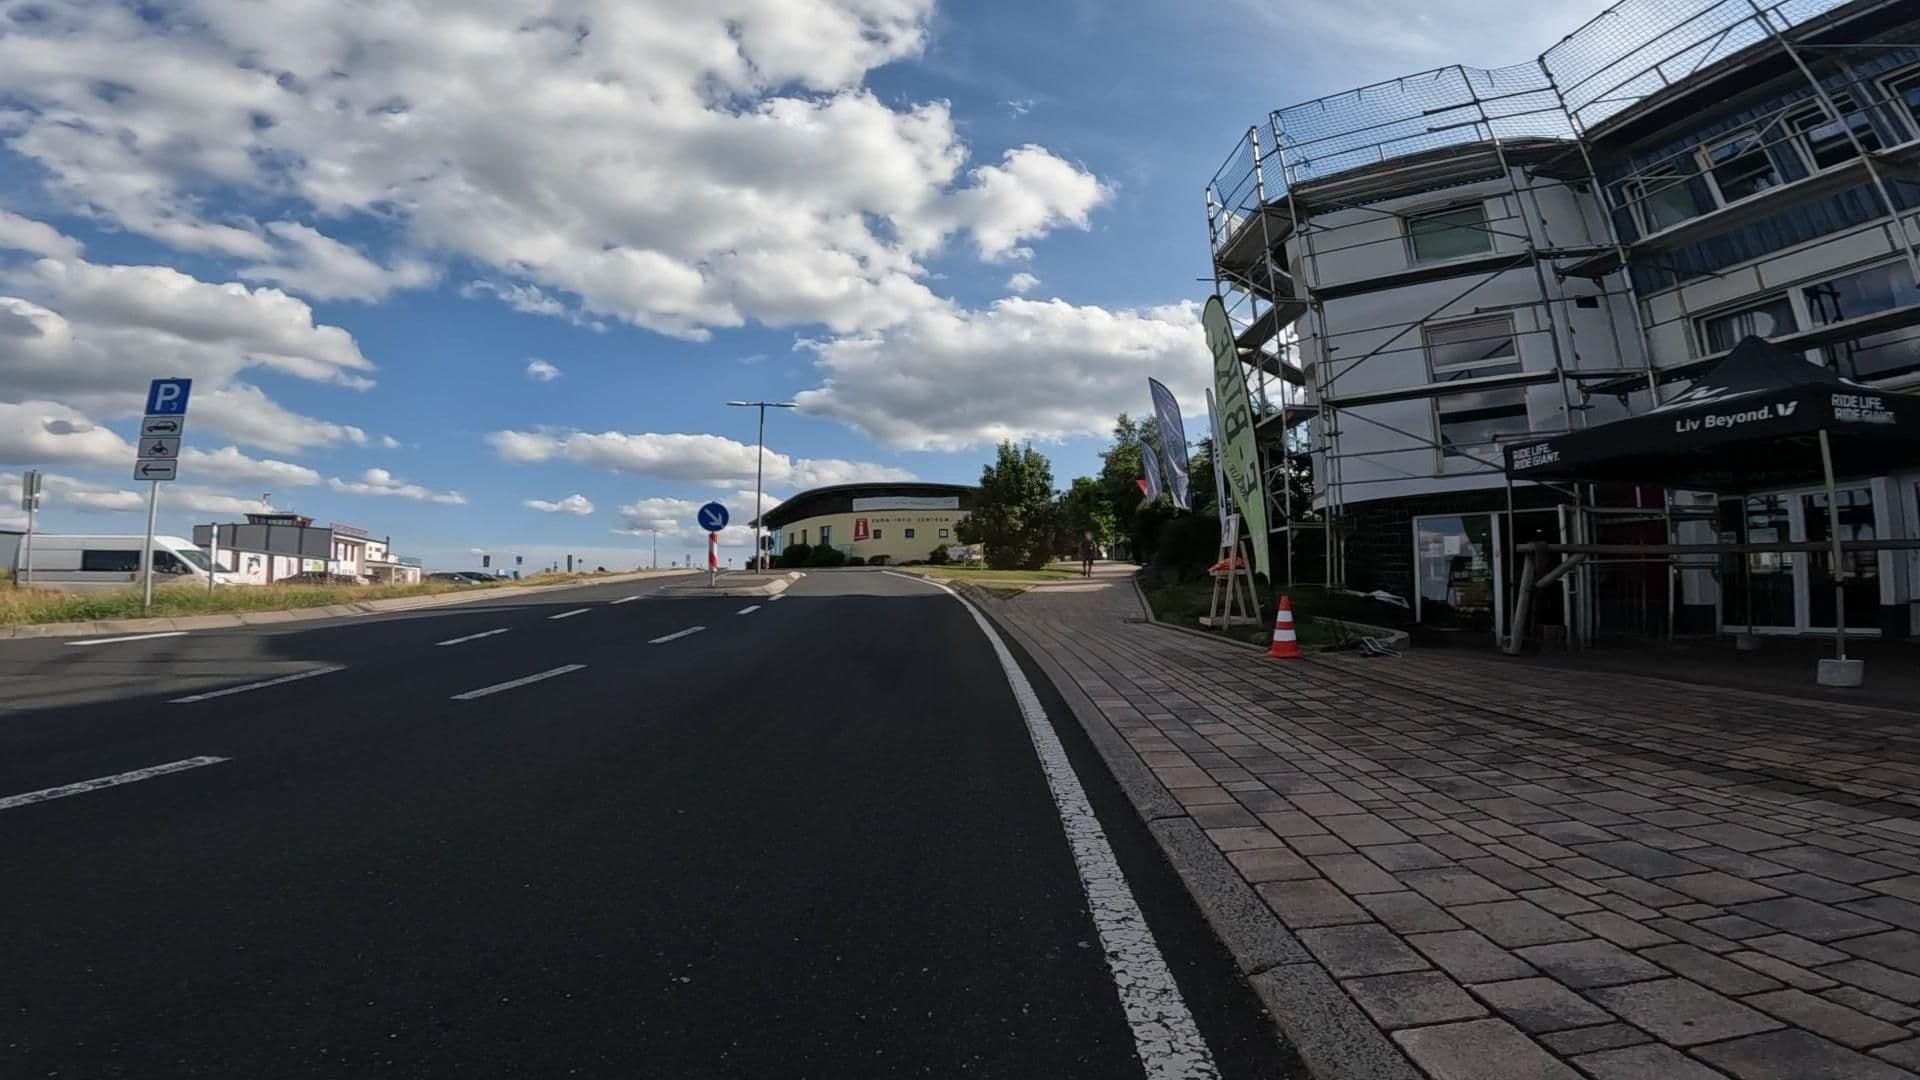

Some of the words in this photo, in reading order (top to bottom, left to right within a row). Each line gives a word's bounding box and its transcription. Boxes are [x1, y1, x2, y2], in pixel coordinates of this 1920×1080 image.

[155, 383, 181, 411] P
[1832, 393, 1858, 408] RIDE
[1676, 419, 1700, 433] Liv
[1705, 405, 1773, 428] Beyond.
[1513, 447, 1531, 460] RIDE
[1513, 457, 1532, 471] RIDE
